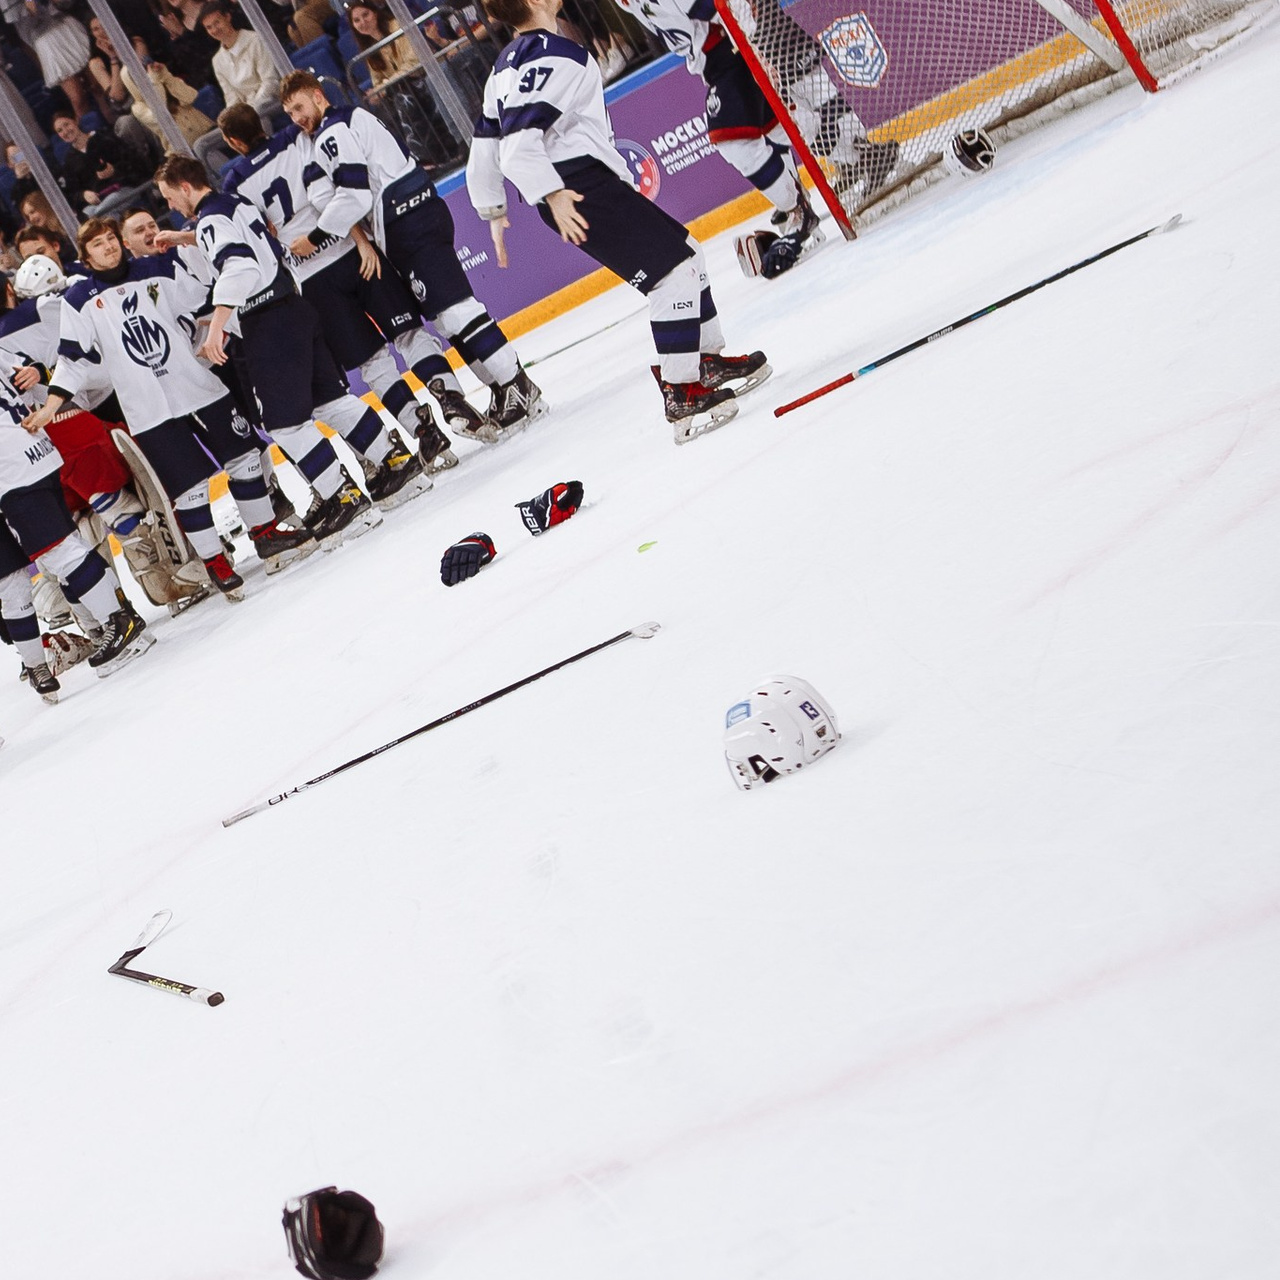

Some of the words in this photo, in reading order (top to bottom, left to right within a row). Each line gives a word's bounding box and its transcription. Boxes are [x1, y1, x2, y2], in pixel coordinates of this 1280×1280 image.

[518, 66, 555, 94] 97
[319, 135, 340, 162] 16
[395, 187, 432, 217] CCM
